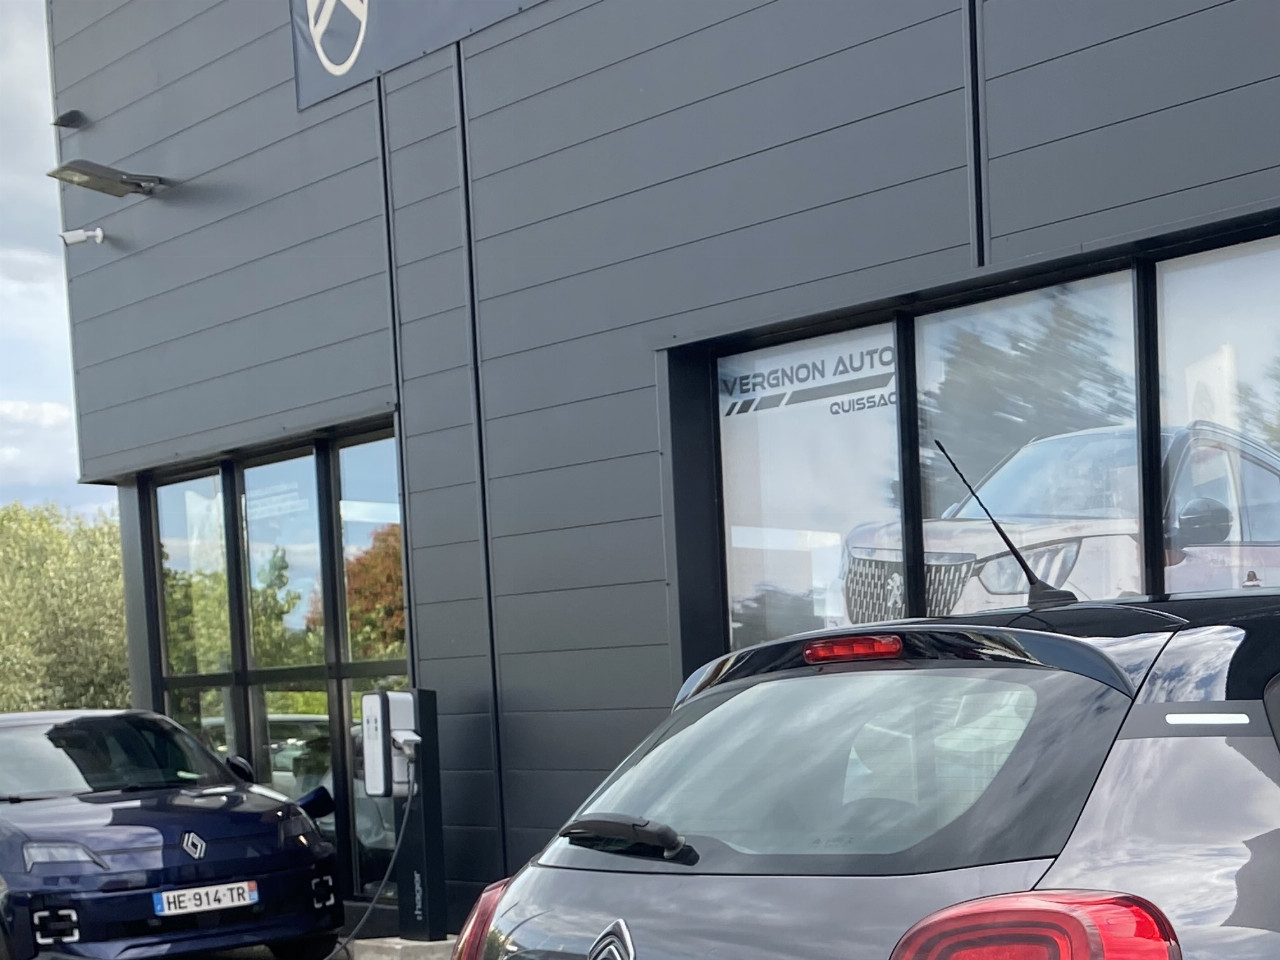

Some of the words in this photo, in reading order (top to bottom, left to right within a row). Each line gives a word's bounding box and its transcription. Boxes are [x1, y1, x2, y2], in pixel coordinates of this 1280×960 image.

[723, 360, 825, 396] VERGNON
[832, 346, 896, 376] AUTO
[830, 391, 896, 415] QUISSAC
